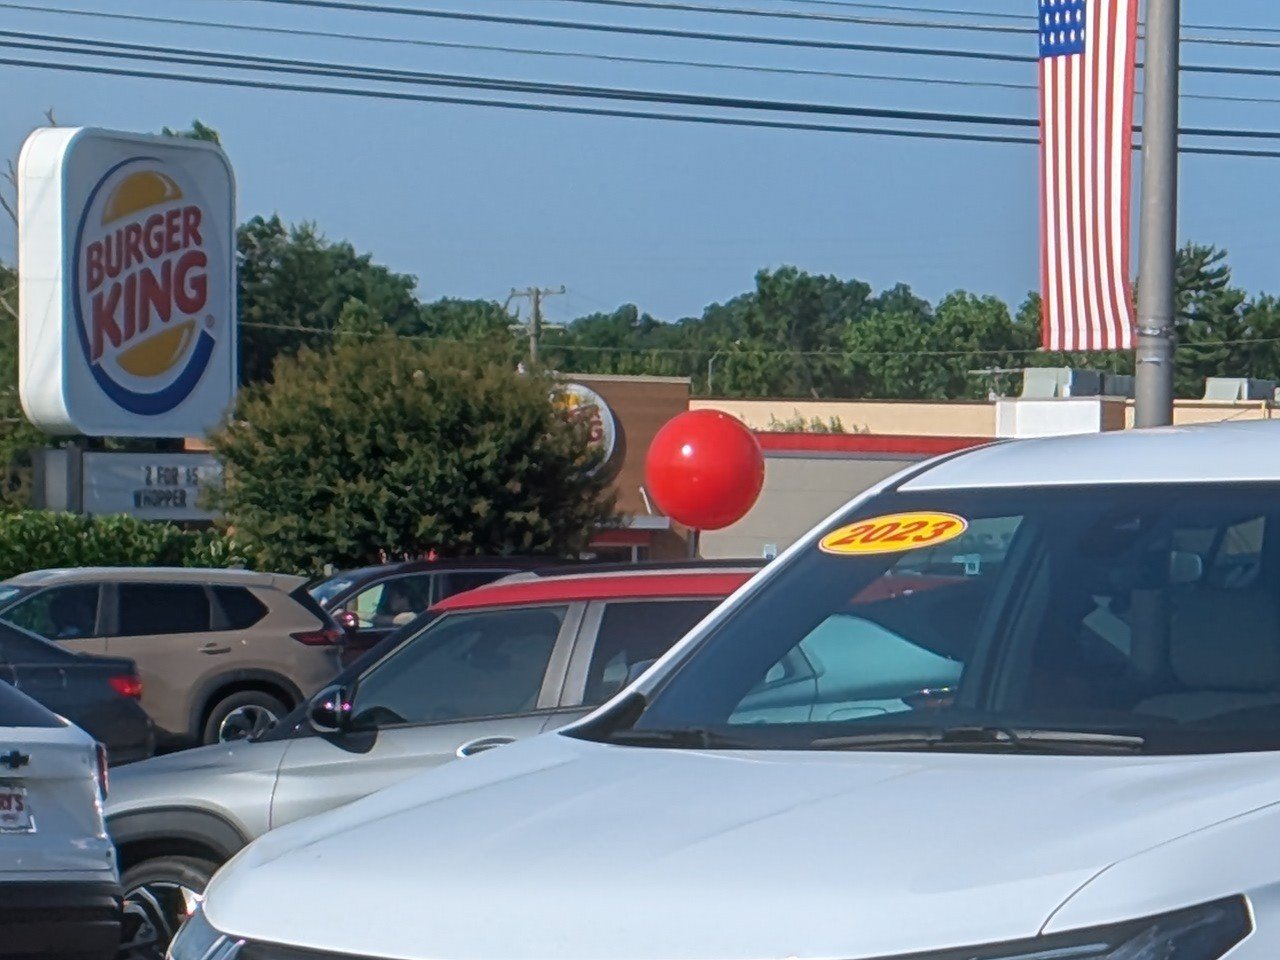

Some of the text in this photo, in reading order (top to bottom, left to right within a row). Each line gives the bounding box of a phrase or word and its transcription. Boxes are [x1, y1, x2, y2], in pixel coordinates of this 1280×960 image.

[86, 205, 202, 293] BURGER
[91, 250, 208, 361] KING
[157, 465, 179, 486] FOR
[132, 488, 187, 509] WHOPPER
[828, 520, 957, 547] 2023
